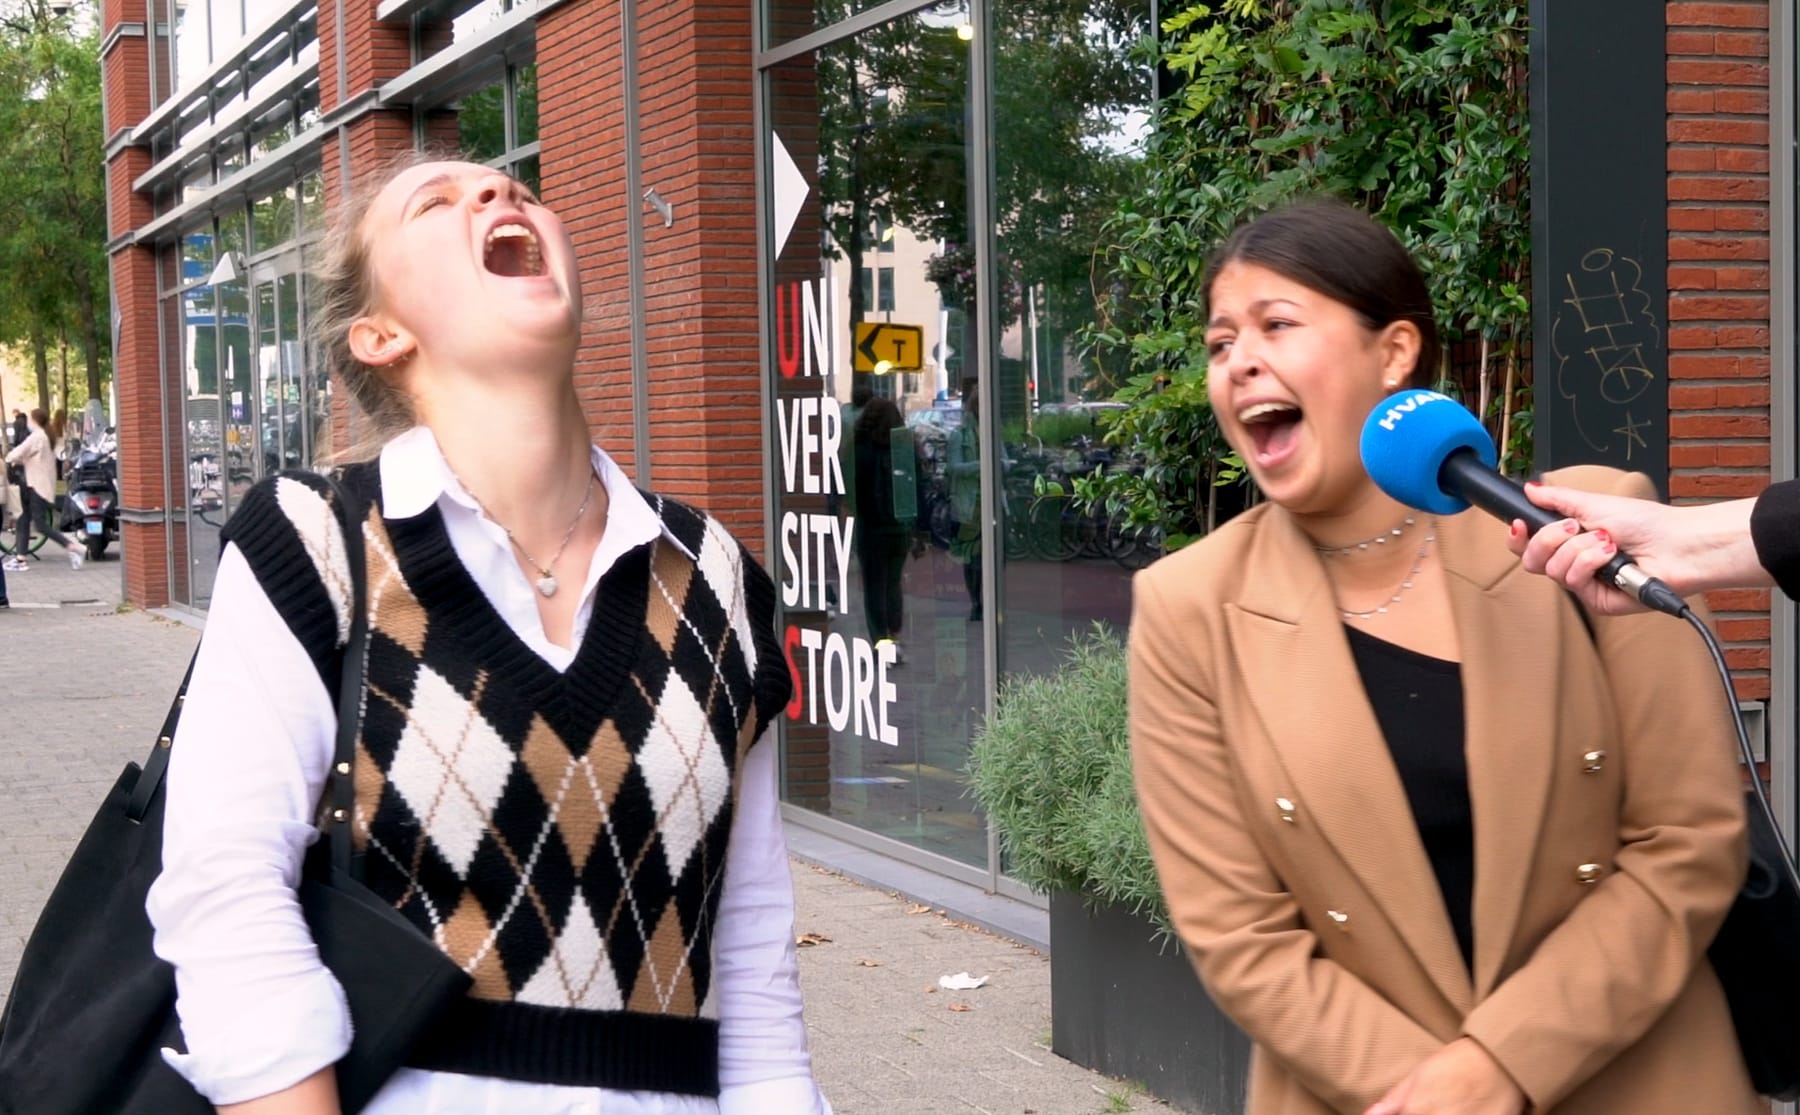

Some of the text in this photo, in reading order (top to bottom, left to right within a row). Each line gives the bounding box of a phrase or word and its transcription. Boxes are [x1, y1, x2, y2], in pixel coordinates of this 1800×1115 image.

[776, 277, 840, 379] UNI
[776, 397, 846, 495] VER
[781, 511, 855, 614] SITY
[784, 625, 899, 747] STORE
